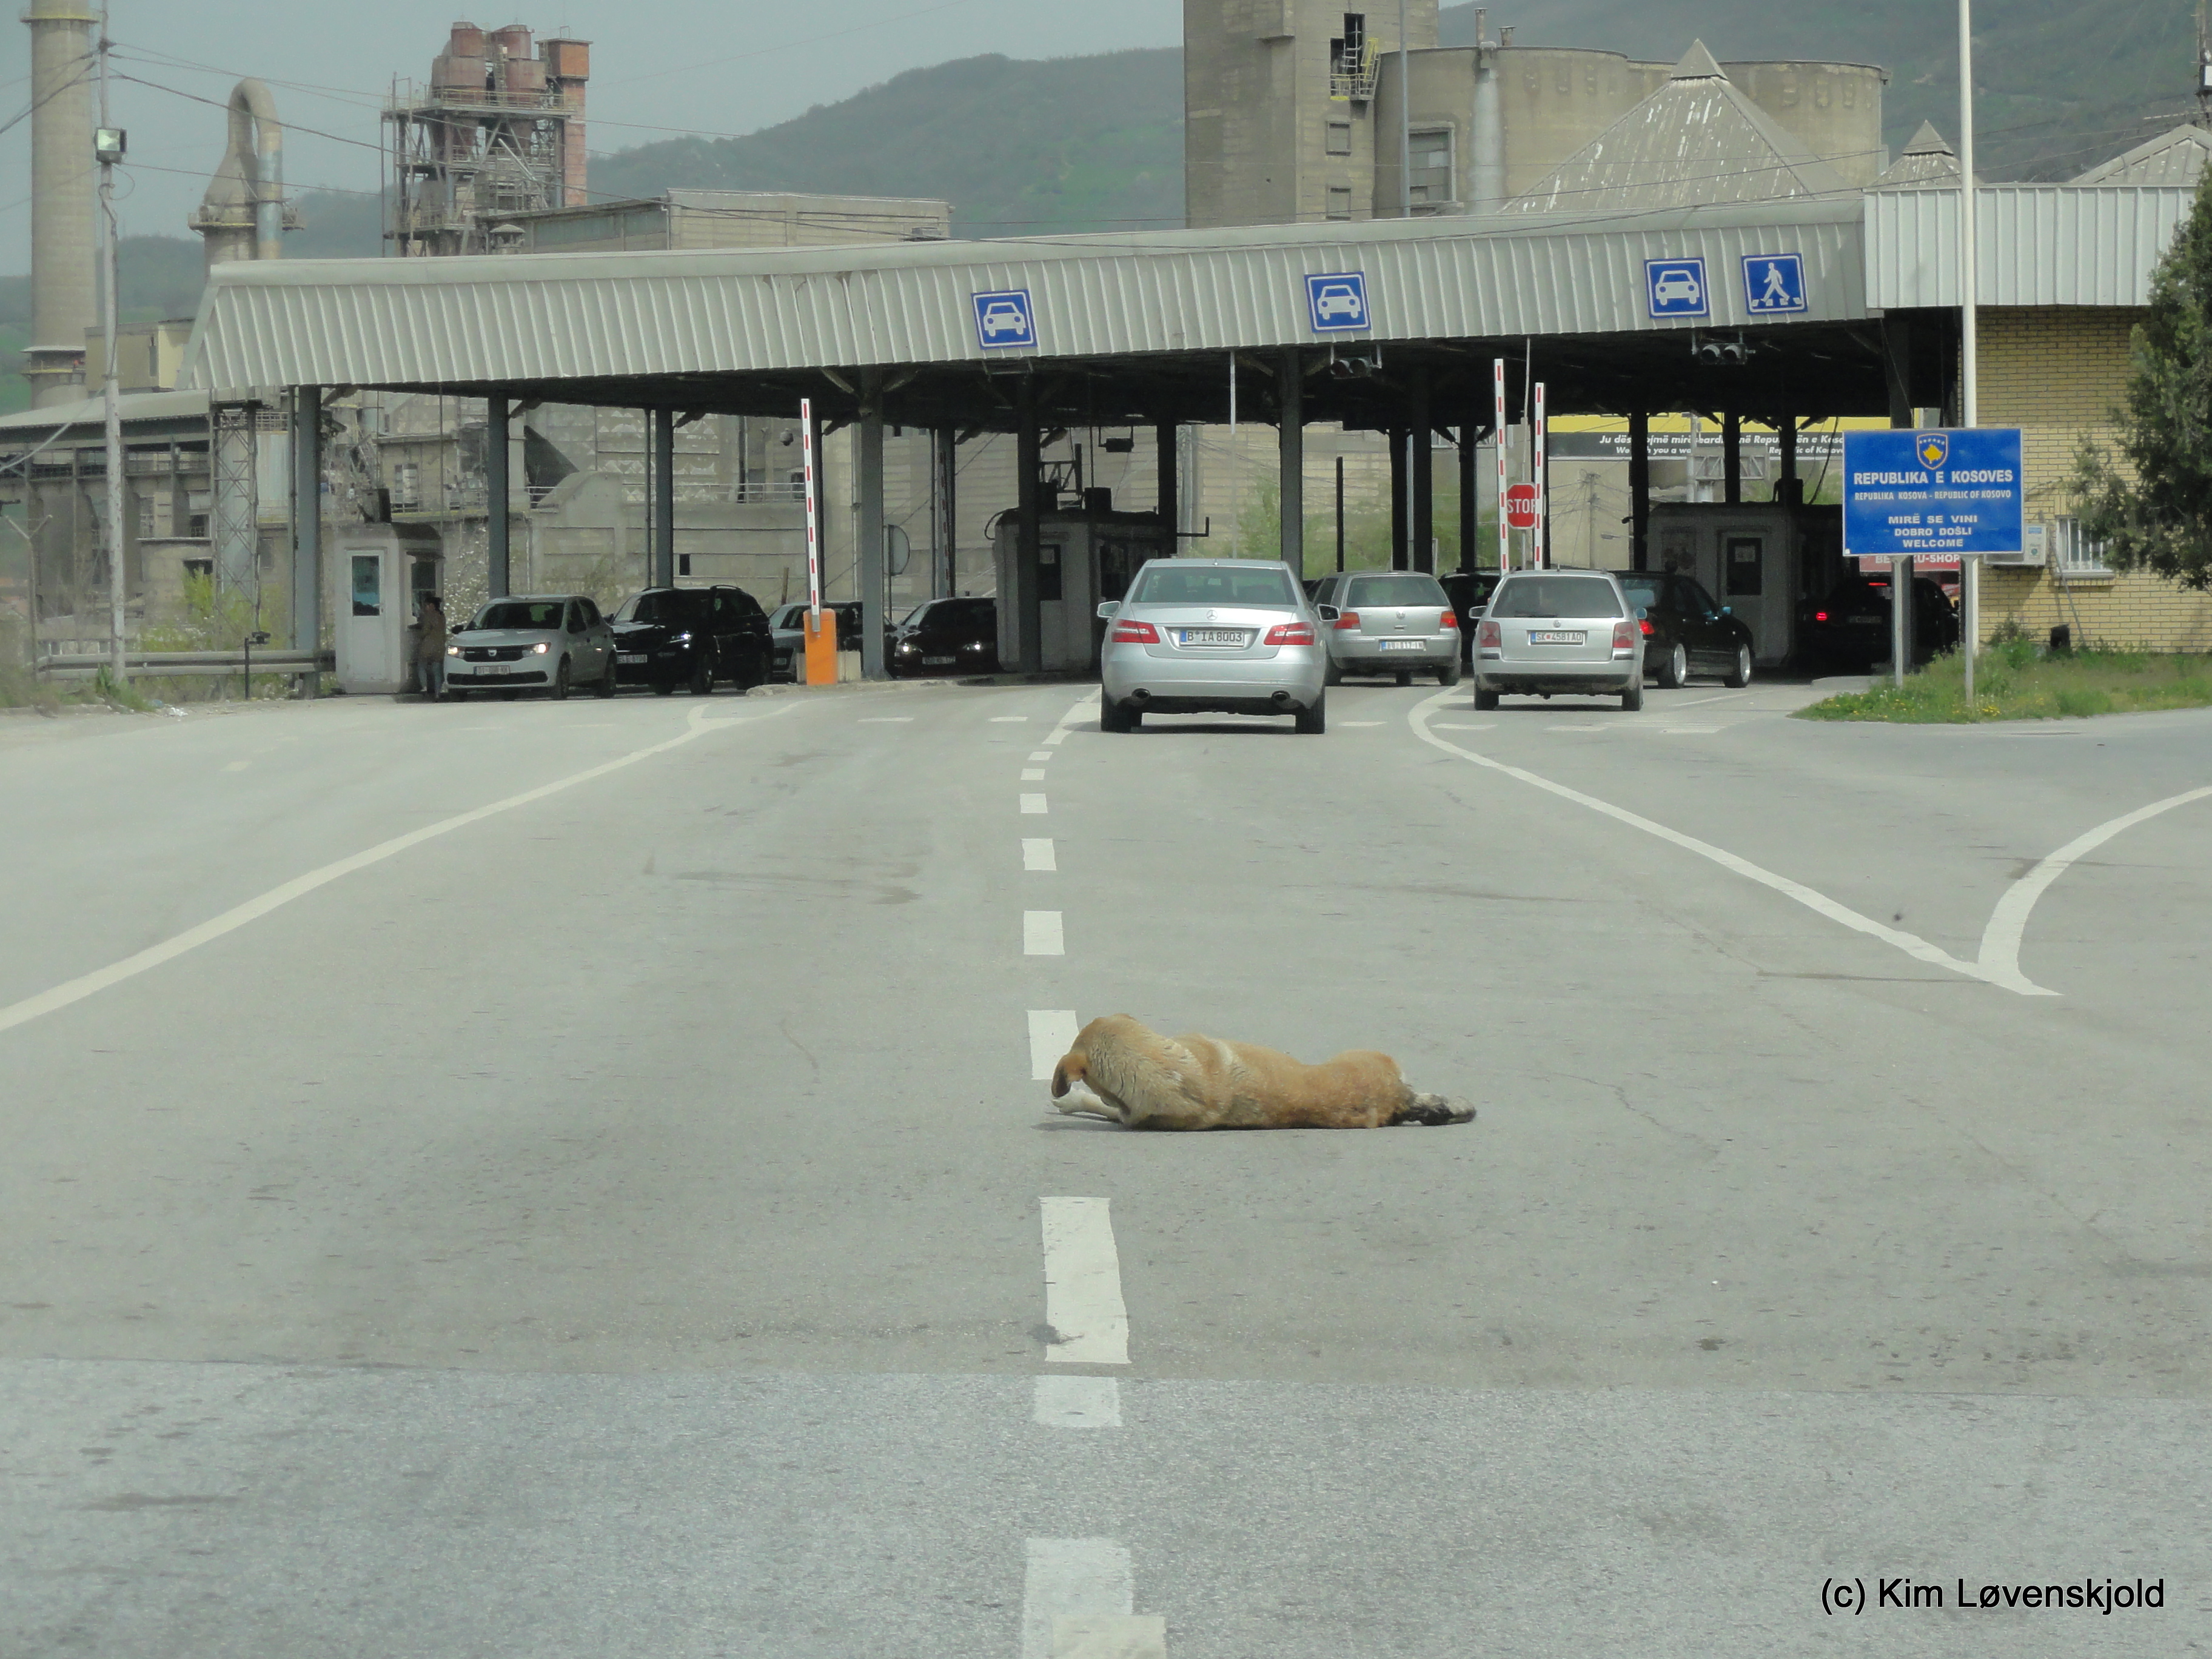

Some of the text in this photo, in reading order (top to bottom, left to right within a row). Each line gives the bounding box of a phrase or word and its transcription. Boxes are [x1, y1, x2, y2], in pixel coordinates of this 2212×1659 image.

[1599, 435, 1611, 443] Ju
[1854, 469, 2013, 484] REPUBLIKA E KOSOVES
[1855, 492, 1894, 500] REPUBLIKA
[1899, 491, 1927, 500] KOSOVA
[1934, 491, 1968, 499] REPUBLIC
[1939, 526, 1972, 535] DOŠLI
[1903, 539, 1963, 548] WELCOME
[1187, 631, 1242, 642] B IA 8003
